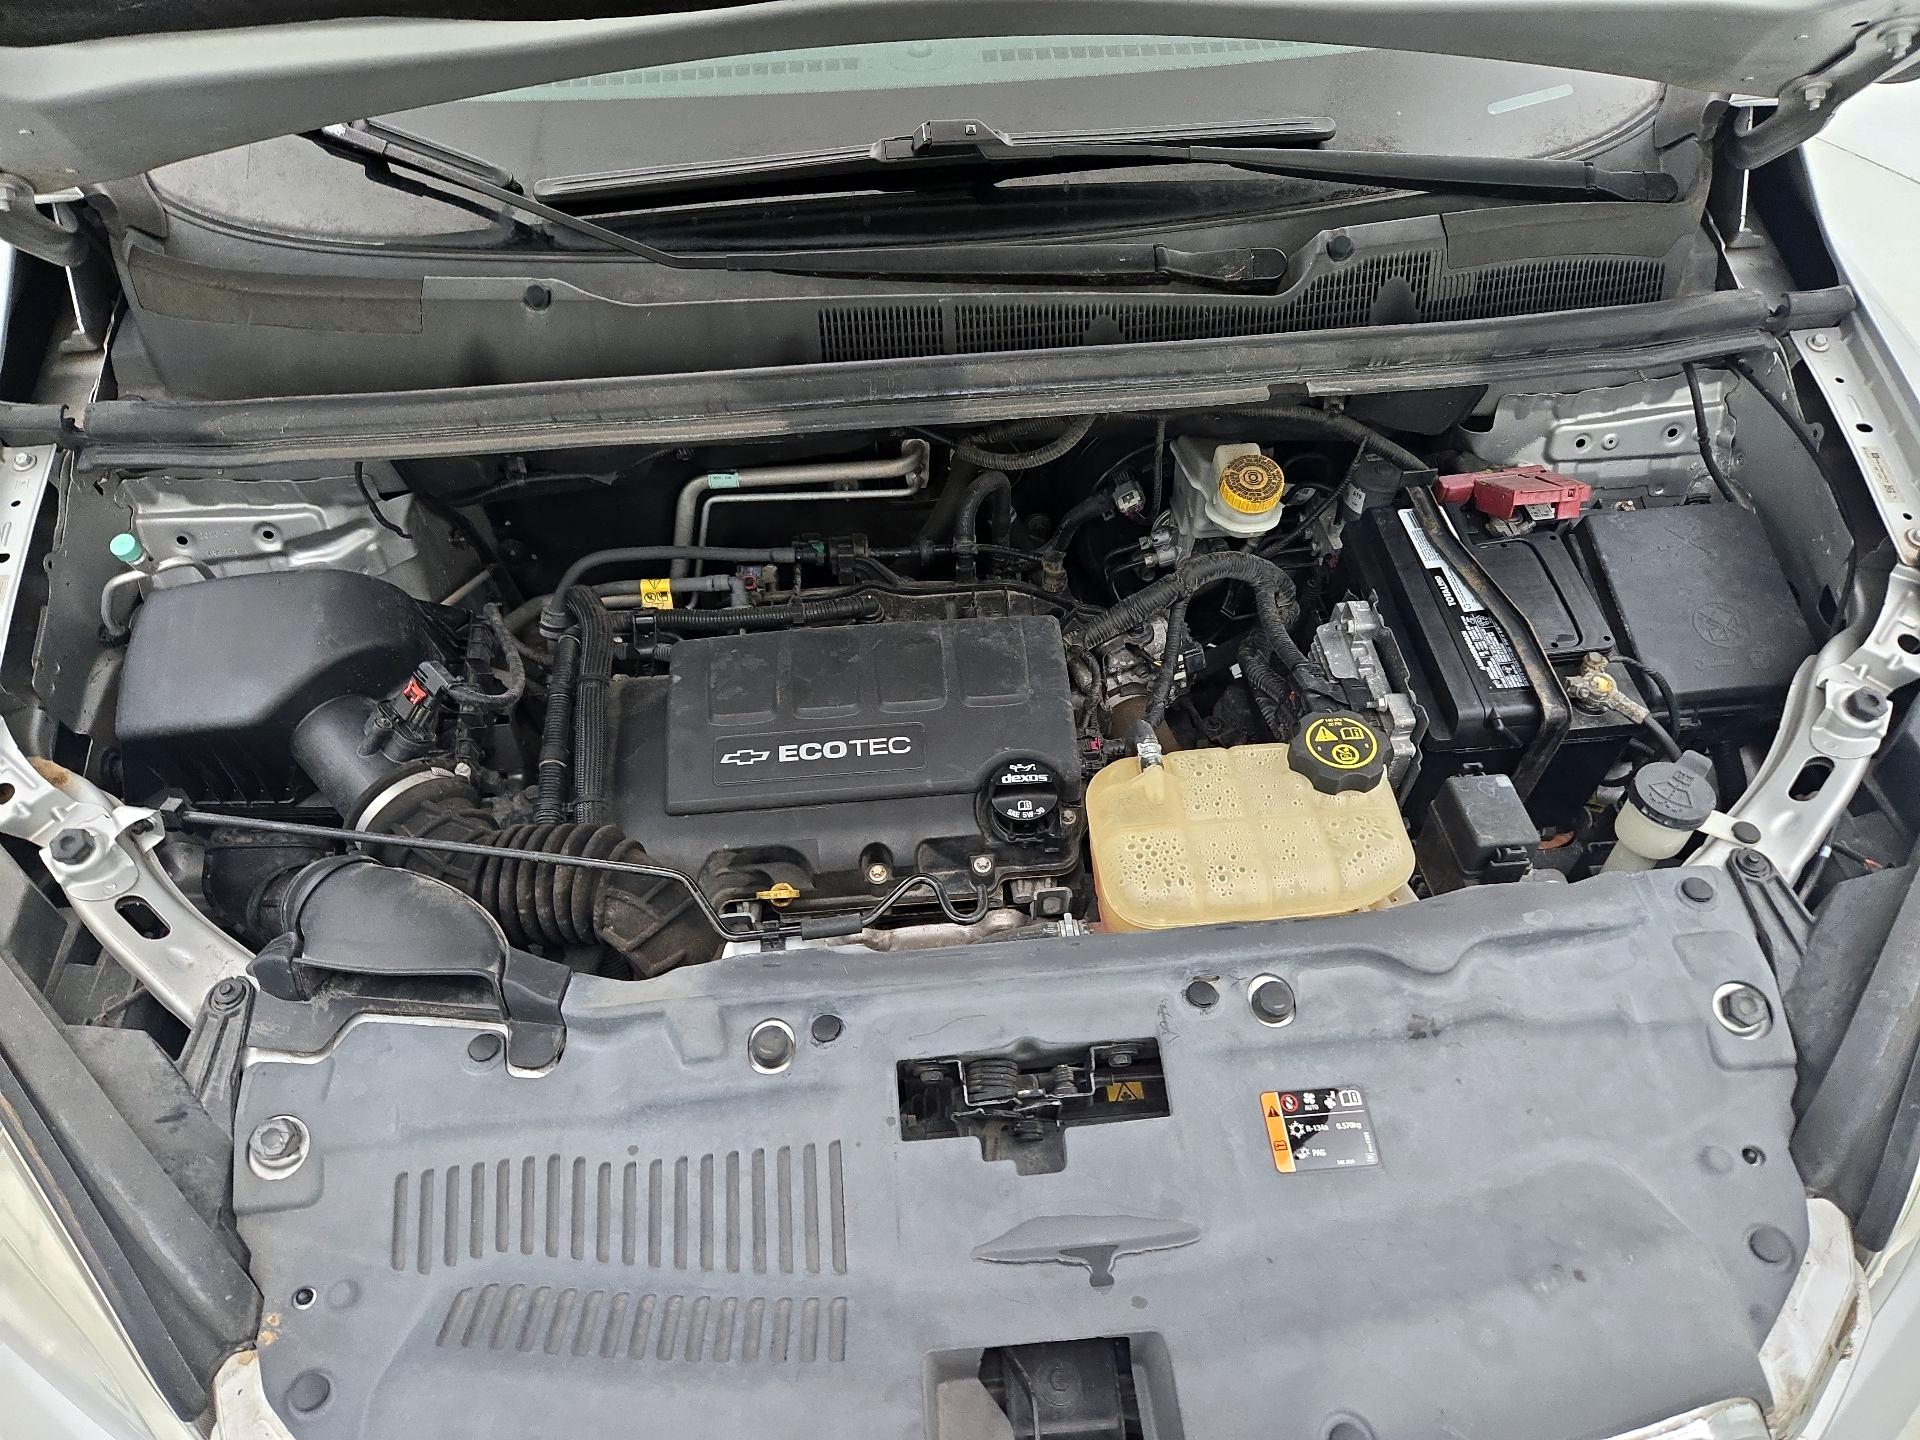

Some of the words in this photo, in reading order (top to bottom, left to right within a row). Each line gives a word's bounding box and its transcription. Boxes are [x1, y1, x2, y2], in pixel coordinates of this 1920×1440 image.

[778, 736, 912, 763] ECOTEC
[1001, 773, 1049, 784] dexos
[1006, 808, 1021, 818] SAE
[1311, 1148, 1327, 1157] PAG
